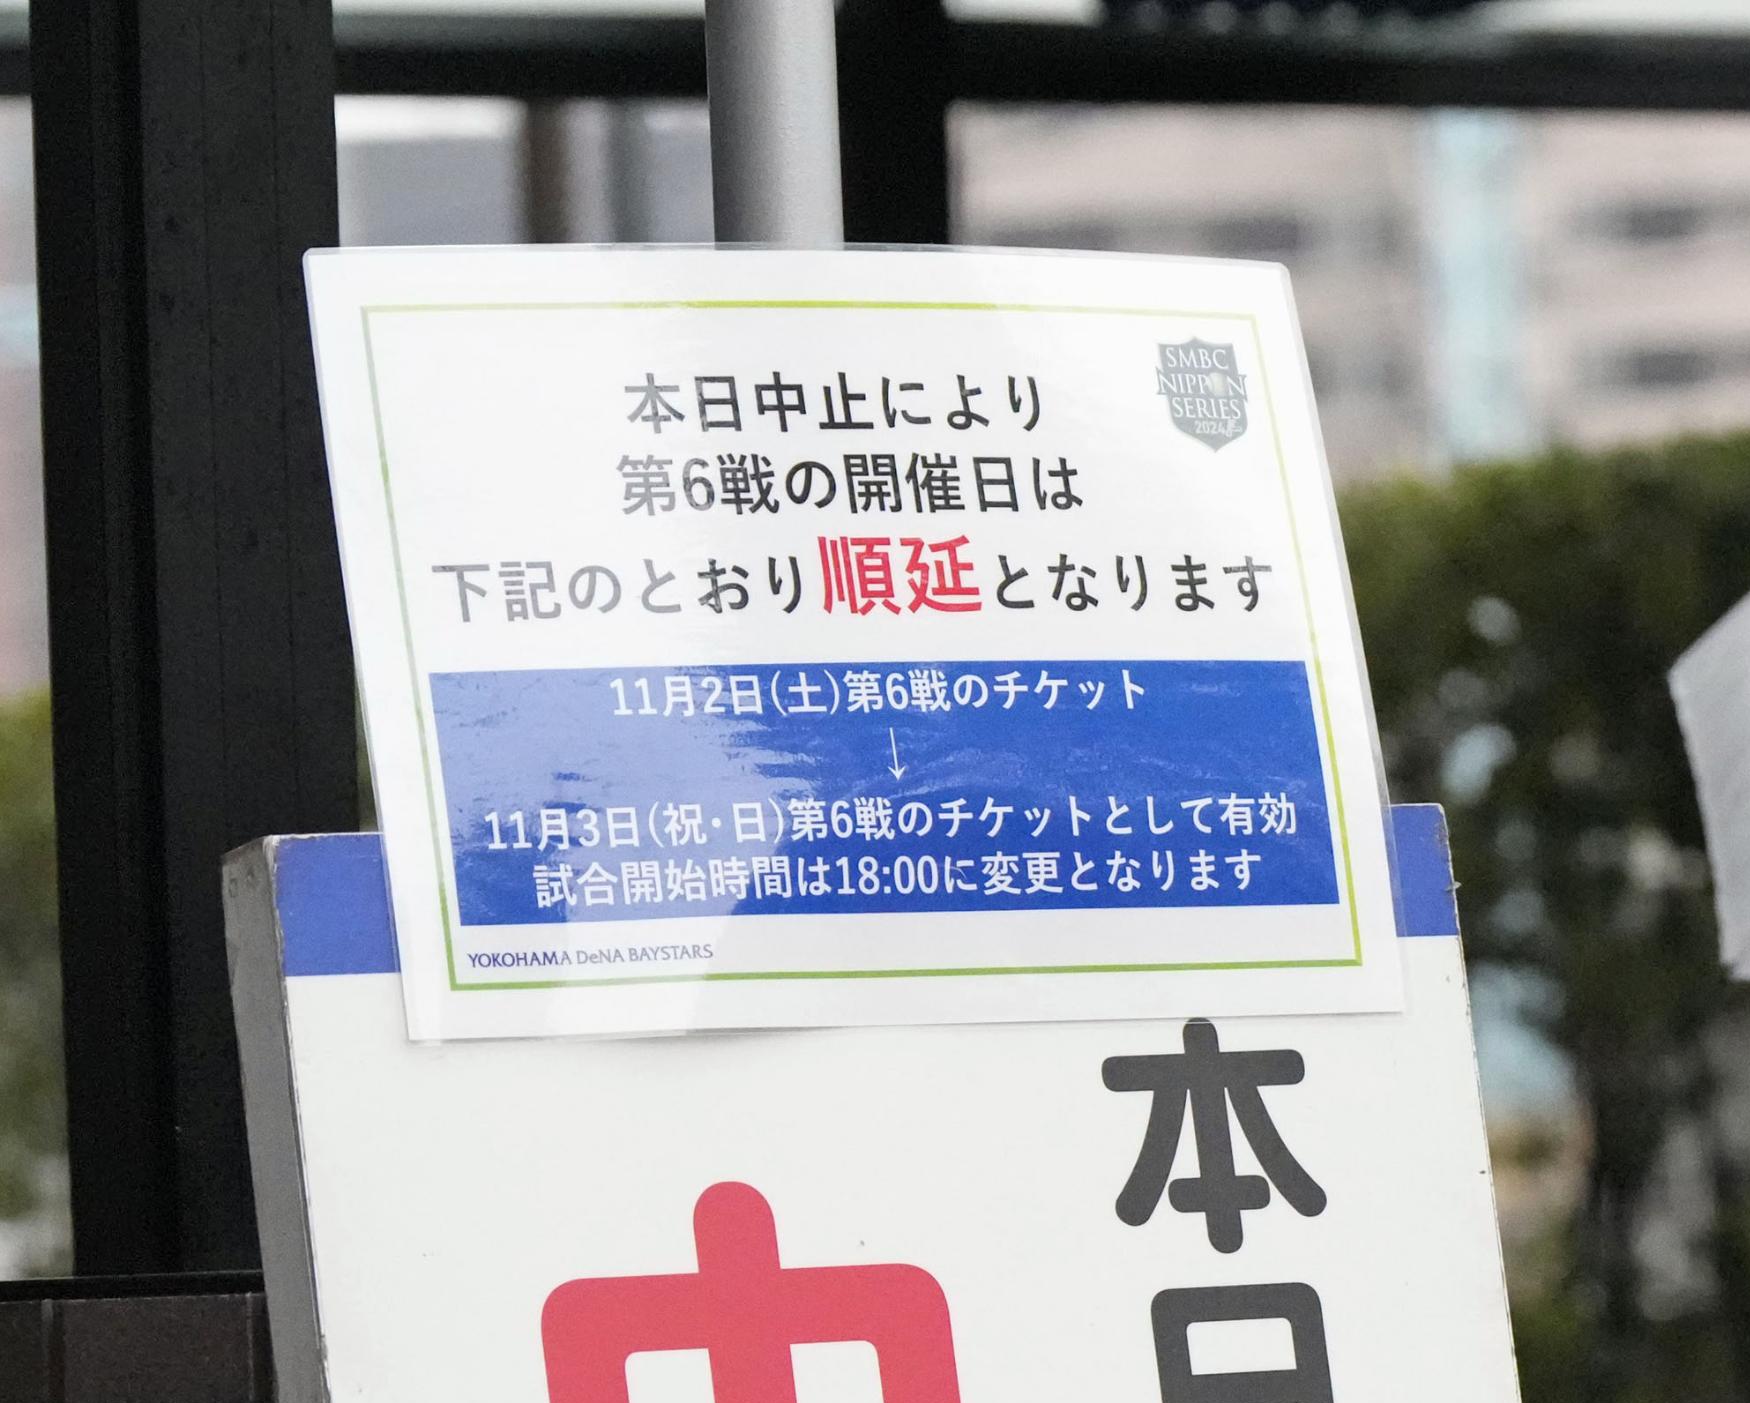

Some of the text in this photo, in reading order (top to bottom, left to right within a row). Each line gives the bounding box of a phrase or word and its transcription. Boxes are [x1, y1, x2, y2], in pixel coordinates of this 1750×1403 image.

[1165, 346, 1229, 370] SMBC
[624, 371, 1041, 435] 本日中止により
[1171, 397, 1242, 420] SERIES
[616, 452, 1083, 516] 第6戦の開催日は
[533, 848, 1261, 908] 試合開始時間は18:00に変更となります
[468, 944, 713, 969] YOKOHAMA DeNA BAYSTARS
